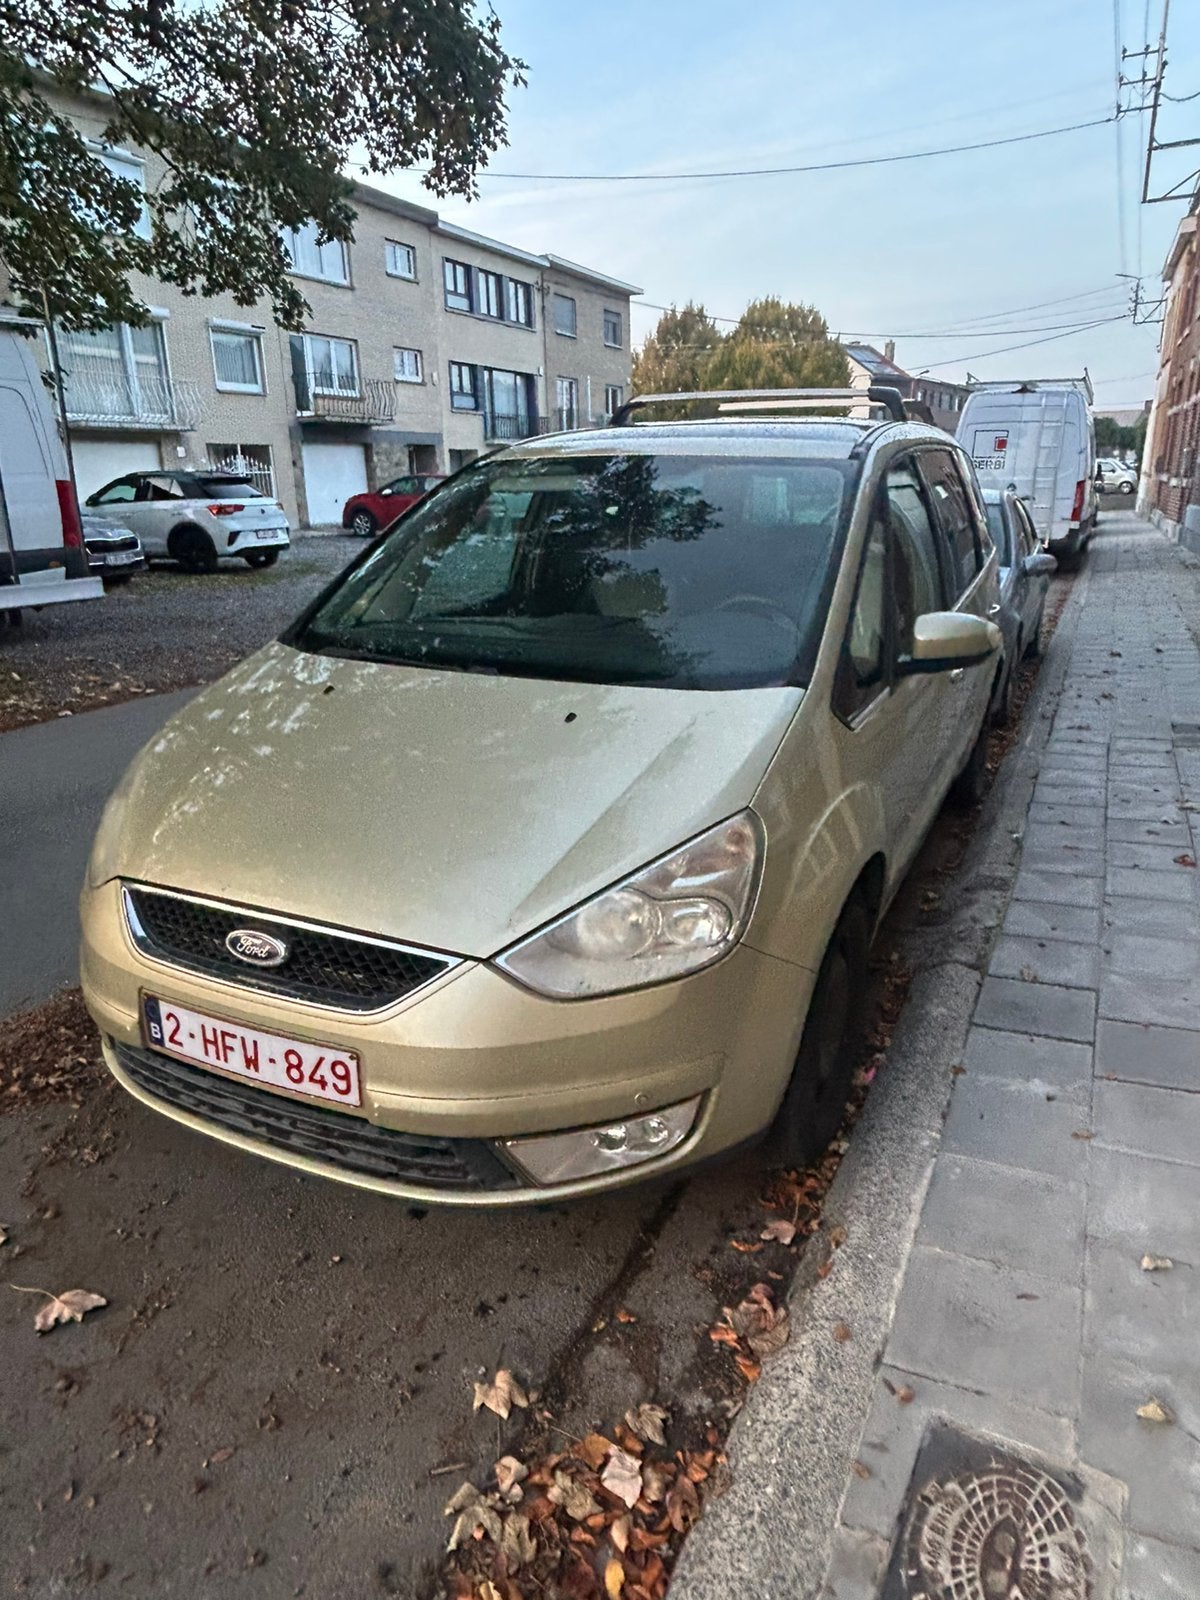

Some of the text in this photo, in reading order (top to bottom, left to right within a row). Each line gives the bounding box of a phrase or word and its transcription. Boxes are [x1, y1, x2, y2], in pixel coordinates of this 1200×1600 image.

[236, 935, 271, 958] Ford
[150, 1021, 162, 1039] B
[165, 1012, 353, 1096] 2-HFW-849
